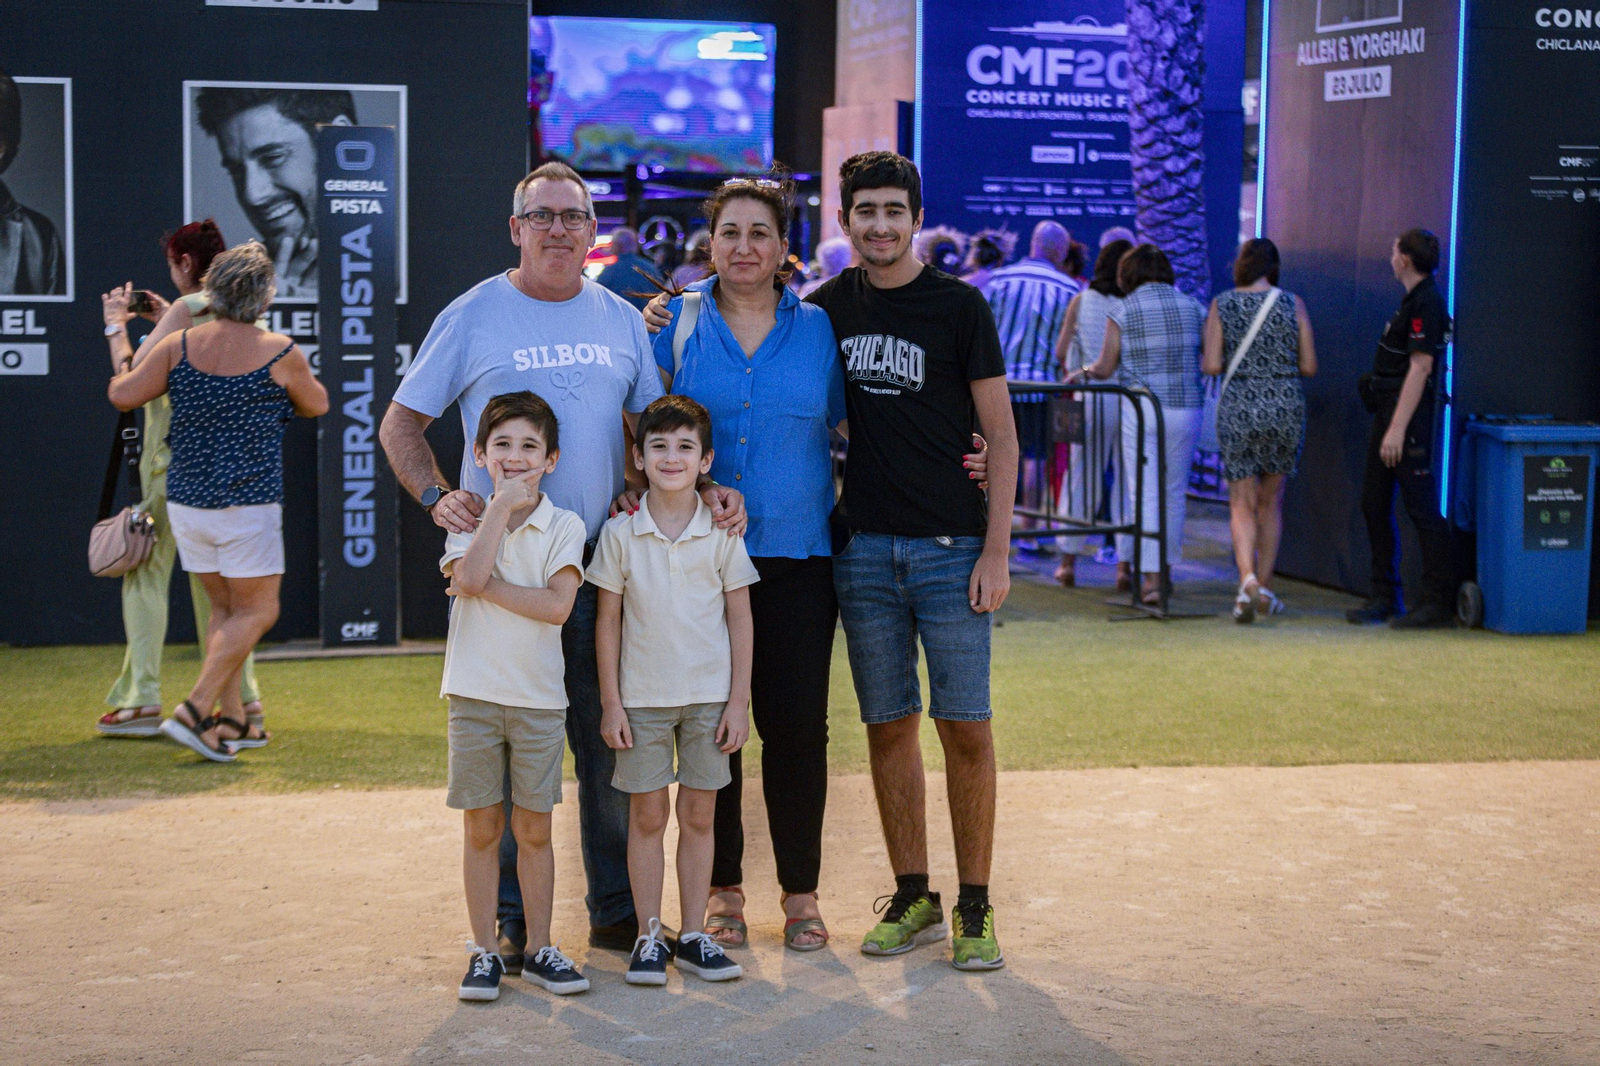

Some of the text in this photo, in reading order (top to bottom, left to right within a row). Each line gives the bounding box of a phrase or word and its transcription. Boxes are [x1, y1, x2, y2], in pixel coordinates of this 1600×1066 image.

[1350, 27, 1425, 60] YORGHAKI
[1348, 72, 1383, 94] JULIO
[966, 89, 1051, 106] CONCERT
[1054, 92, 1112, 108] MUSIC
[324, 180, 388, 191] GENERAL
[330, 199, 383, 214] PISTA
[0, 309, 47, 335] EL
[513, 343, 613, 371] SILBON
[841, 334, 925, 389] CHICAGO
[341, 224, 376, 568] GENERAL PISTA
[341, 621, 379, 637] CMF
